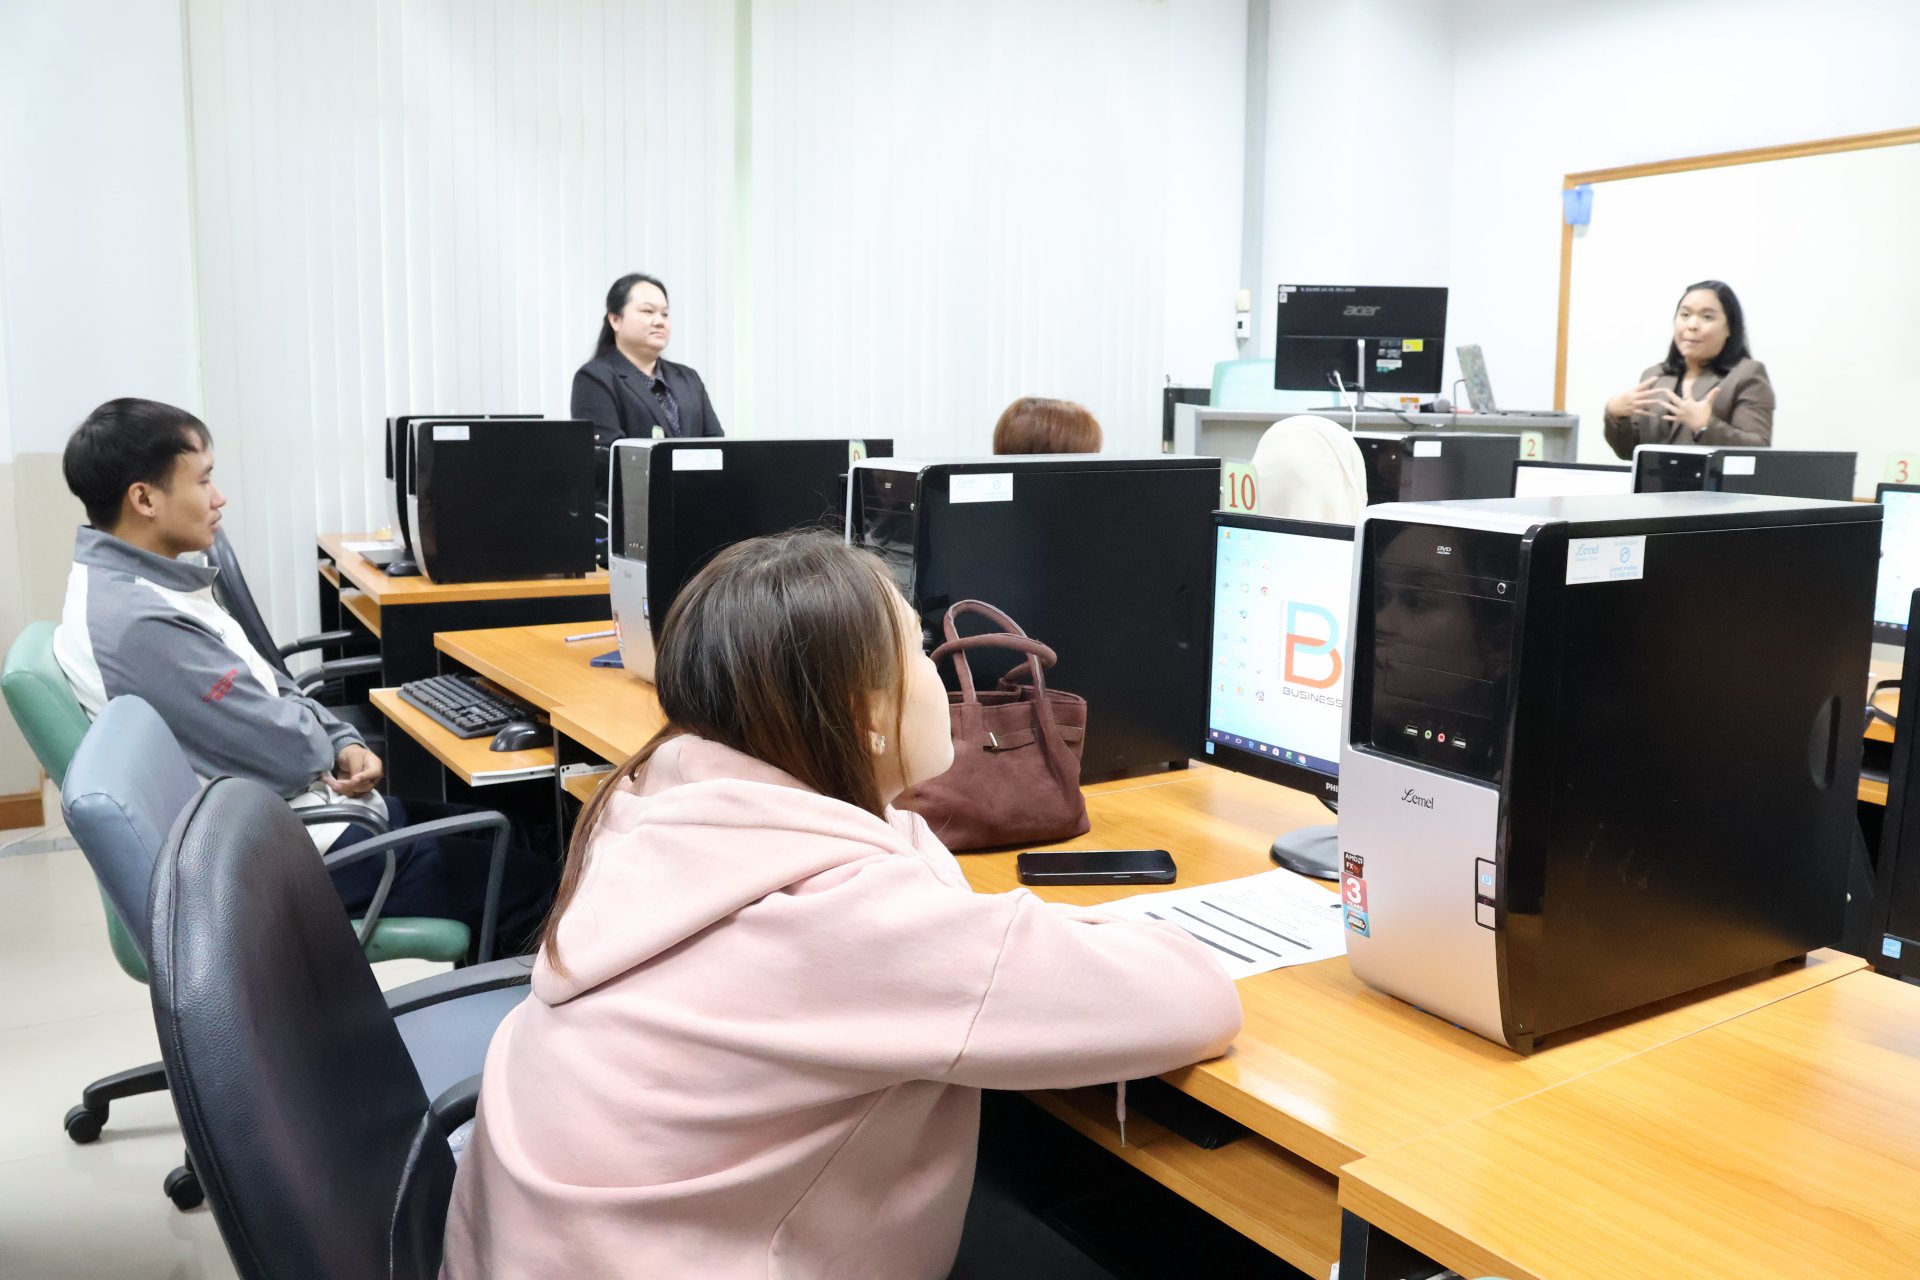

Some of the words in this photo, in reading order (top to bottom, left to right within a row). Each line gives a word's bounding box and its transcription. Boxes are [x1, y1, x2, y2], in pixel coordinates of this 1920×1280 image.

[1343, 305, 1381, 316] acer
[1527, 438, 1536, 457] 2
[1895, 460, 1909, 483] 3
[1229, 472, 1256, 511] 10
[1282, 686, 1343, 708] BUSINESS
[1401, 788, 1434, 810] Lemel
[1346, 861, 1353, 869] FX
[1346, 877, 1362, 904] 3
